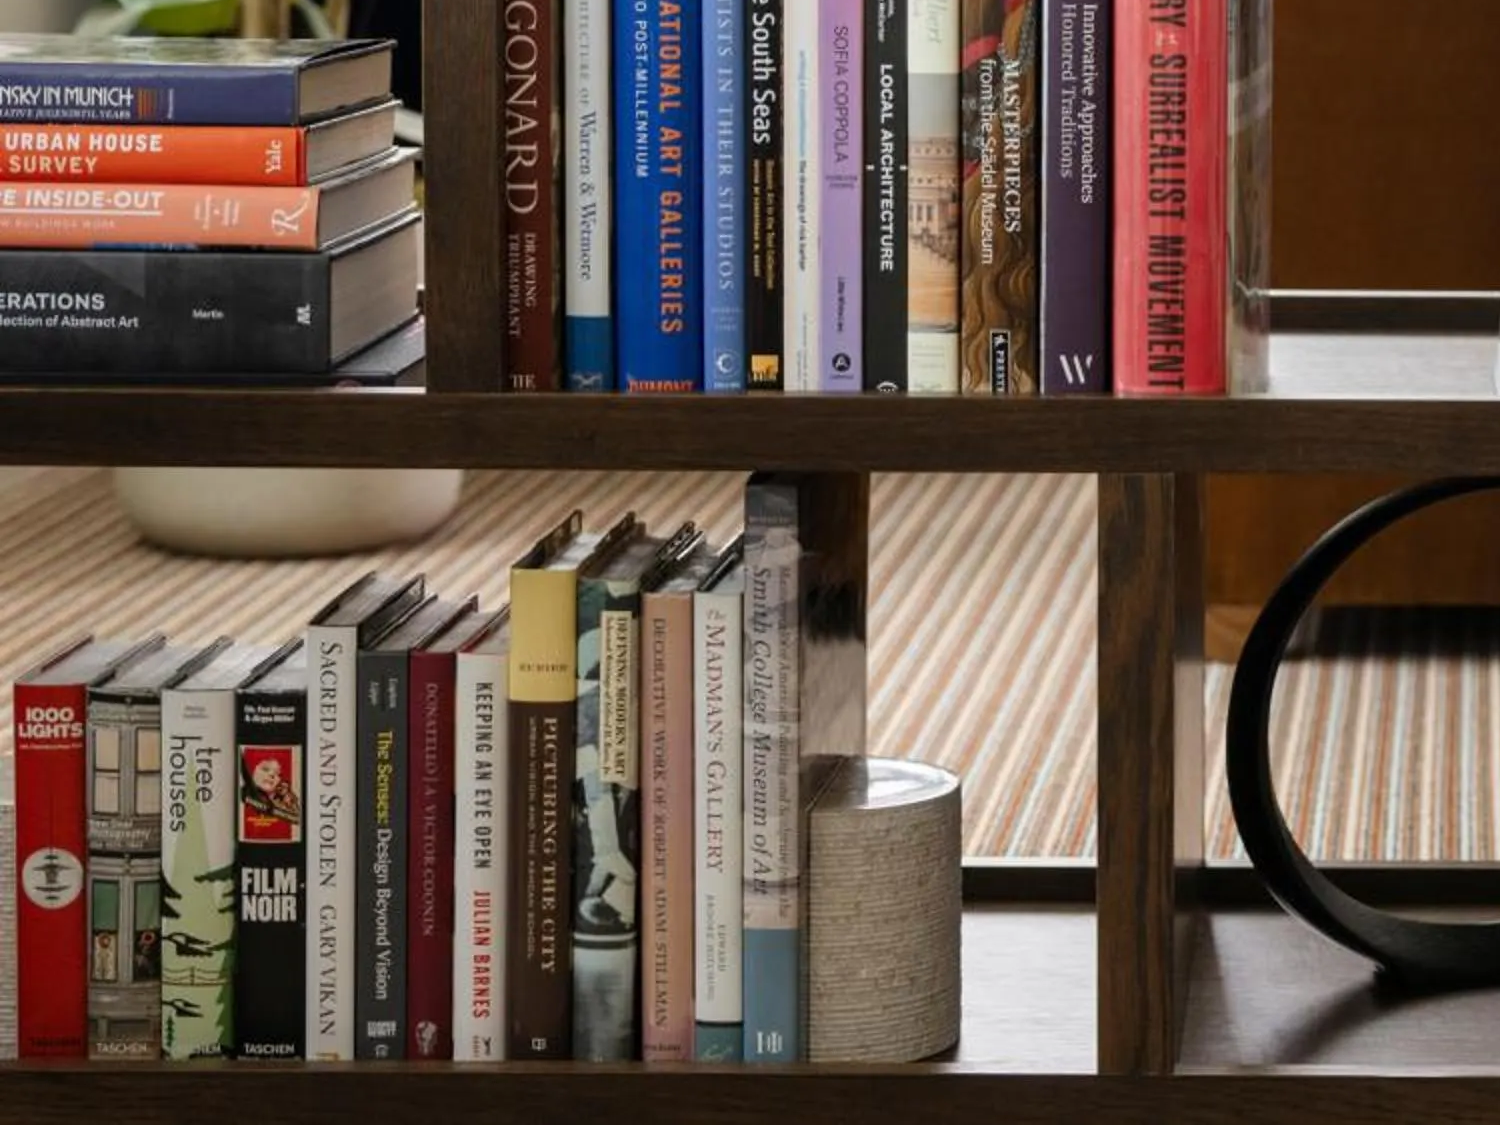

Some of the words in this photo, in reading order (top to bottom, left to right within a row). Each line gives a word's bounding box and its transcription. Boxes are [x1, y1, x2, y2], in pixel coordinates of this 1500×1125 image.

[752, 13, 777, 81] South
[833, 25, 850, 76] SOFIA
[1061, 3, 1077, 80] Honored
[1081, 3, 1098, 96] Innovative
[43, 86, 60, 106] IN
[64, 86, 134, 107] MUNICH
[635, 20, 649, 177] POST-MILLENNIUM
[717, 68, 733, 92] IN
[880, 64, 894, 123] LOCAL
[981, 59, 997, 100] from
[6, 133, 81, 151] URBAN
[88, 134, 163, 152] HOUSE
[579, 111, 598, 176] Warren
[718, 103, 734, 176] THEIR
[752, 88, 777, 144] Seas
[834, 80, 851, 163] COPPOLA
[981, 105, 997, 133] the
[1061, 86, 1077, 178] Traditions
[1149, 54, 1188, 220] SURREALIST
[9, 155, 97, 173] SURVEY
[264, 139, 283, 174] Yale
[659, 126, 683, 176] ART
[981, 137, 999, 189] Städel
[1003, 59, 1021, 233] MASTERPIECES
[1078, 100, 1098, 204] Approaches
[25, 191, 165, 209] INSIDE-OUT
[579, 181, 597, 195] &
[880, 129, 895, 272] ARCHITECTURE
[579, 201, 597, 281] Wetmore
[718, 187, 734, 290] STUDIOS
[982, 193, 997, 264] Museum
[508, 233, 521, 336] TRIUMPHANT
[524, 233, 537, 307] DRAWING
[660, 190, 683, 334] GALLERIES
[45, 315, 59, 327] of
[61, 315, 115, 328] Abstract
[118, 317, 139, 328] Art
[1149, 235, 1186, 391] MOVEMENT
[752, 567, 774, 634] Smith
[615, 617, 628, 682] DEFINING
[653, 618, 667, 726] DECORATIVE
[318, 641, 342, 733] SACRED
[705, 625, 727, 754] MADMAN'S
[750, 640, 772, 724] College
[19, 723, 84, 739] LIGHTS
[26, 707, 74, 723] 1000
[424, 683, 439, 774] DONATELLO
[475, 682, 493, 753] KEEPING
[615, 686, 628, 745] MODERN
[195, 746, 222, 803] tree
[318, 737, 337, 787] AND
[378, 731, 393, 759] The
[475, 760, 493, 781] AN
[615, 751, 626, 776] ART
[653, 731, 667, 783] WORK
[170, 736, 203, 832] houses
[377, 764, 393, 824] Senses:
[475, 789, 493, 819] EYE
[543, 717, 558, 854] PICTURING
[653, 788, 666, 806] OF
[752, 731, 773, 827] Museum
[318, 794, 342, 887] STOLEN
[423, 805, 438, 865] VICTOR
[704, 761, 728, 873] GALLERY
[749, 834, 774, 856] of
[375, 828, 393, 884] Design
[475, 826, 493, 869] OPEN
[653, 815, 667, 879] ROBERT
[241, 867, 298, 894] FILM
[542, 861, 557, 910] THE
[751, 859, 771, 895] Art
[241, 895, 298, 922] NOIR
[318, 905, 337, 961] GARY
[374, 888, 392, 946] Beyond
[474, 891, 492, 946] JULIAN
[654, 888, 667, 933] ADAM
[541, 918, 556, 972] CITY
[318, 962, 337, 1035] VIKAN
[375, 950, 391, 1000] Vision
[474, 954, 492, 1019] BARNES
[654, 942, 668, 1027] STILLMAN
[97, 1042, 148, 1054] TASCHEN
[244, 1043, 296, 1055] TASCHEN
